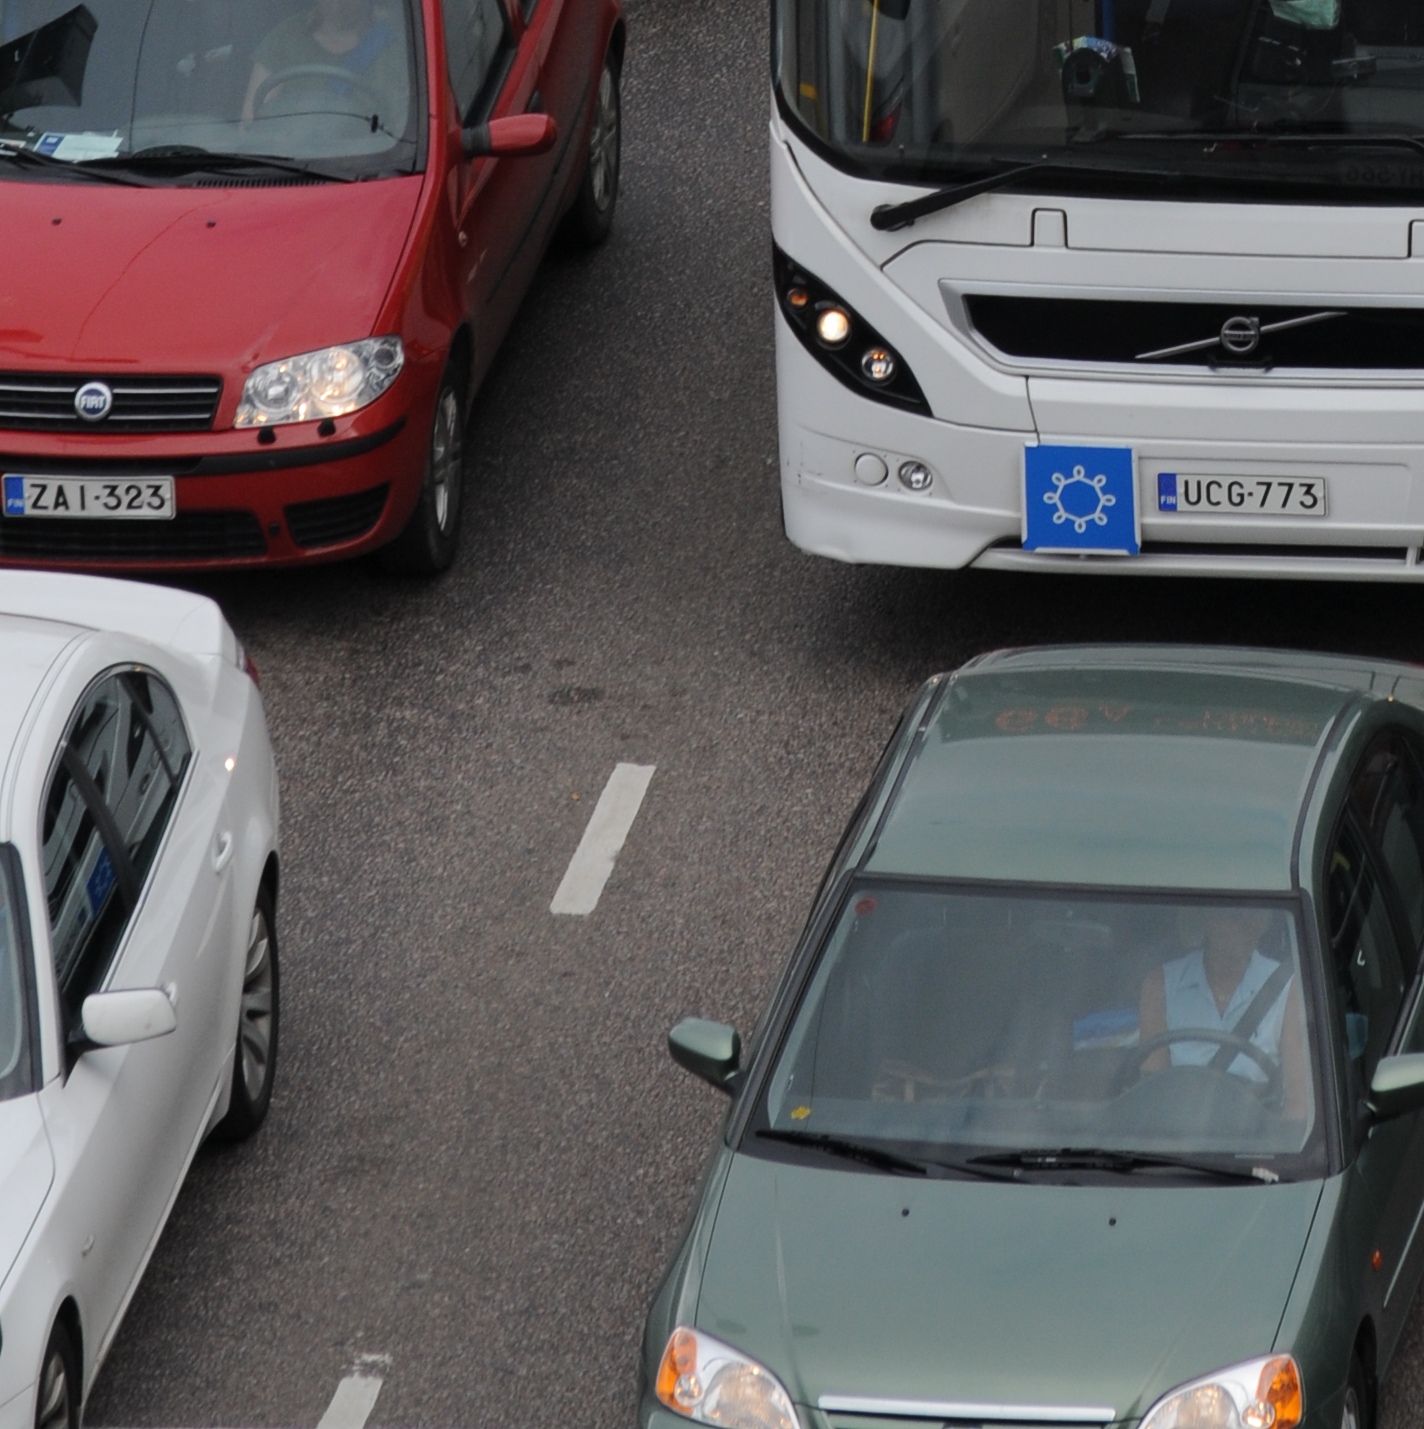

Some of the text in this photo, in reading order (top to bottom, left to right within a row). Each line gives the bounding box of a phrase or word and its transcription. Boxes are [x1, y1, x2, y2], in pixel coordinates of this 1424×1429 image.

[80, 395, 106, 409] FIAT
[30, 483, 167, 511] ZAI-323
[1160, 478, 1319, 510] FIN UCG-773
